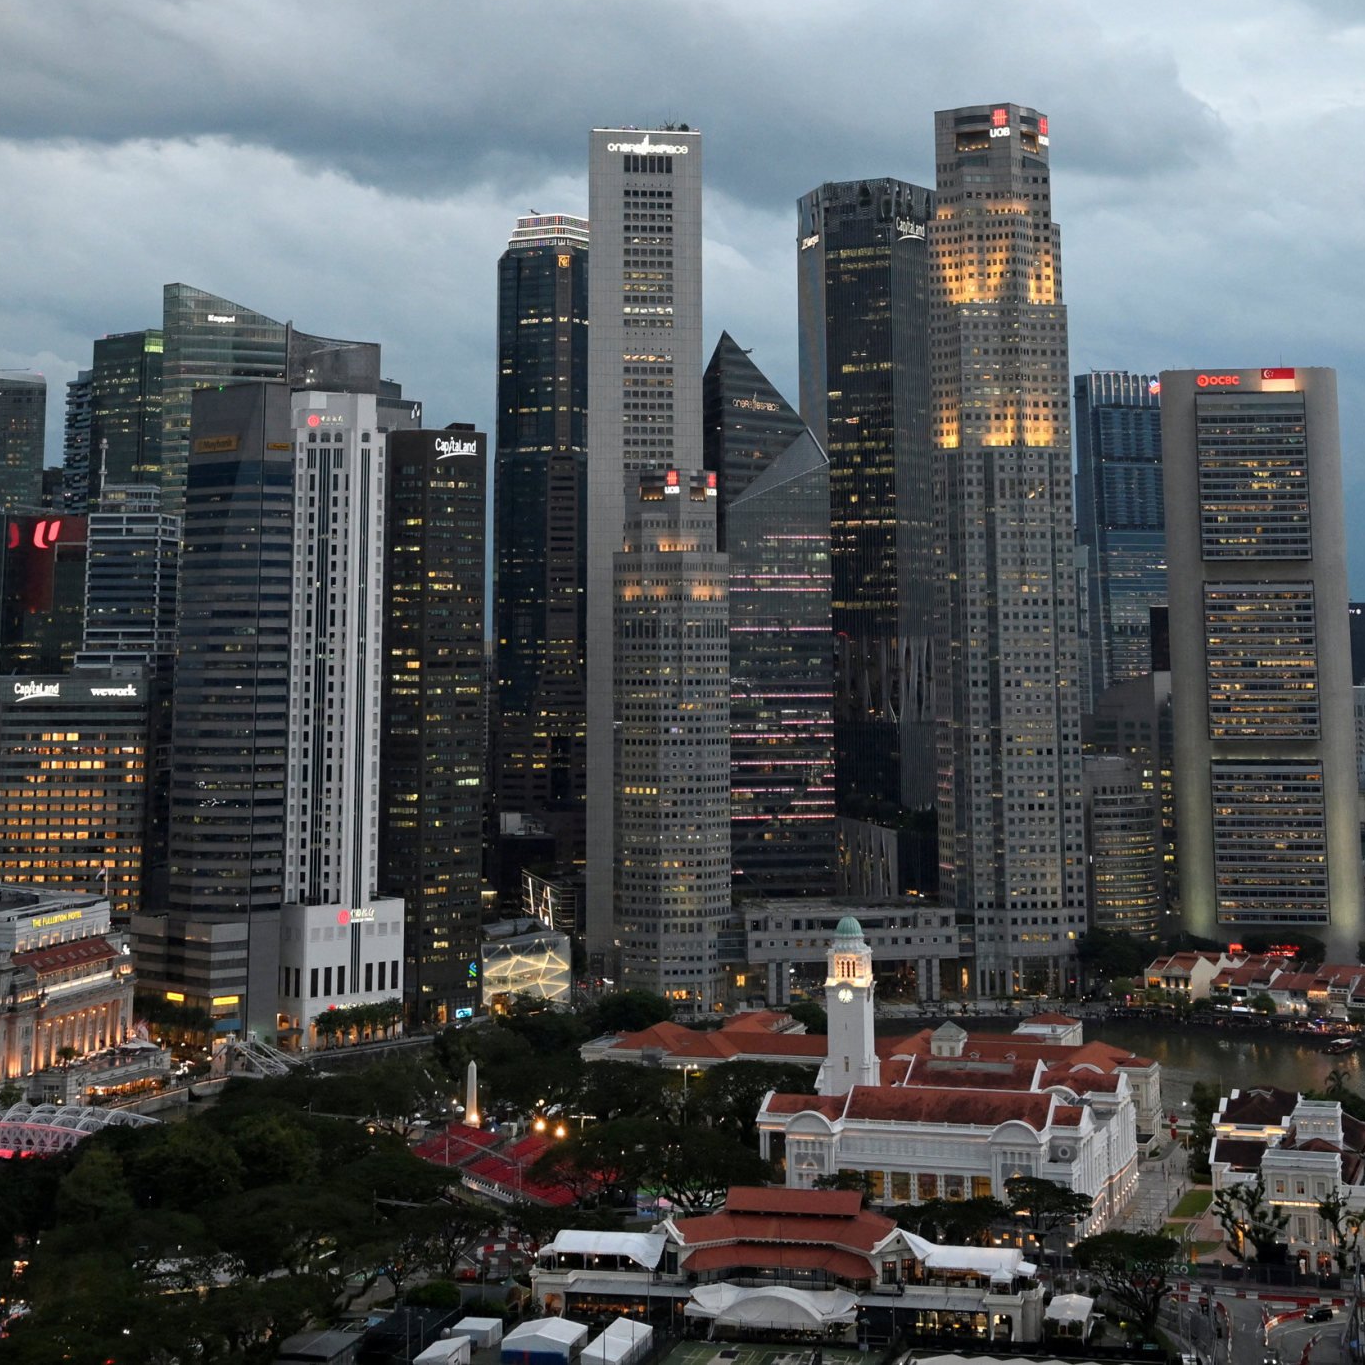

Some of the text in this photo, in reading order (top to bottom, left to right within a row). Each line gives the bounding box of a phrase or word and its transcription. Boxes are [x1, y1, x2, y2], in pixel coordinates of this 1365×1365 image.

[989, 127, 1011, 138] UOB
[896, 216, 925, 237] CapitaLand
[1209, 375, 1241, 386] OCBC
[435, 437, 477, 455] CapitaLand
[14, 681, 60, 697] CapitaLand
[90, 684, 138, 696] wework
